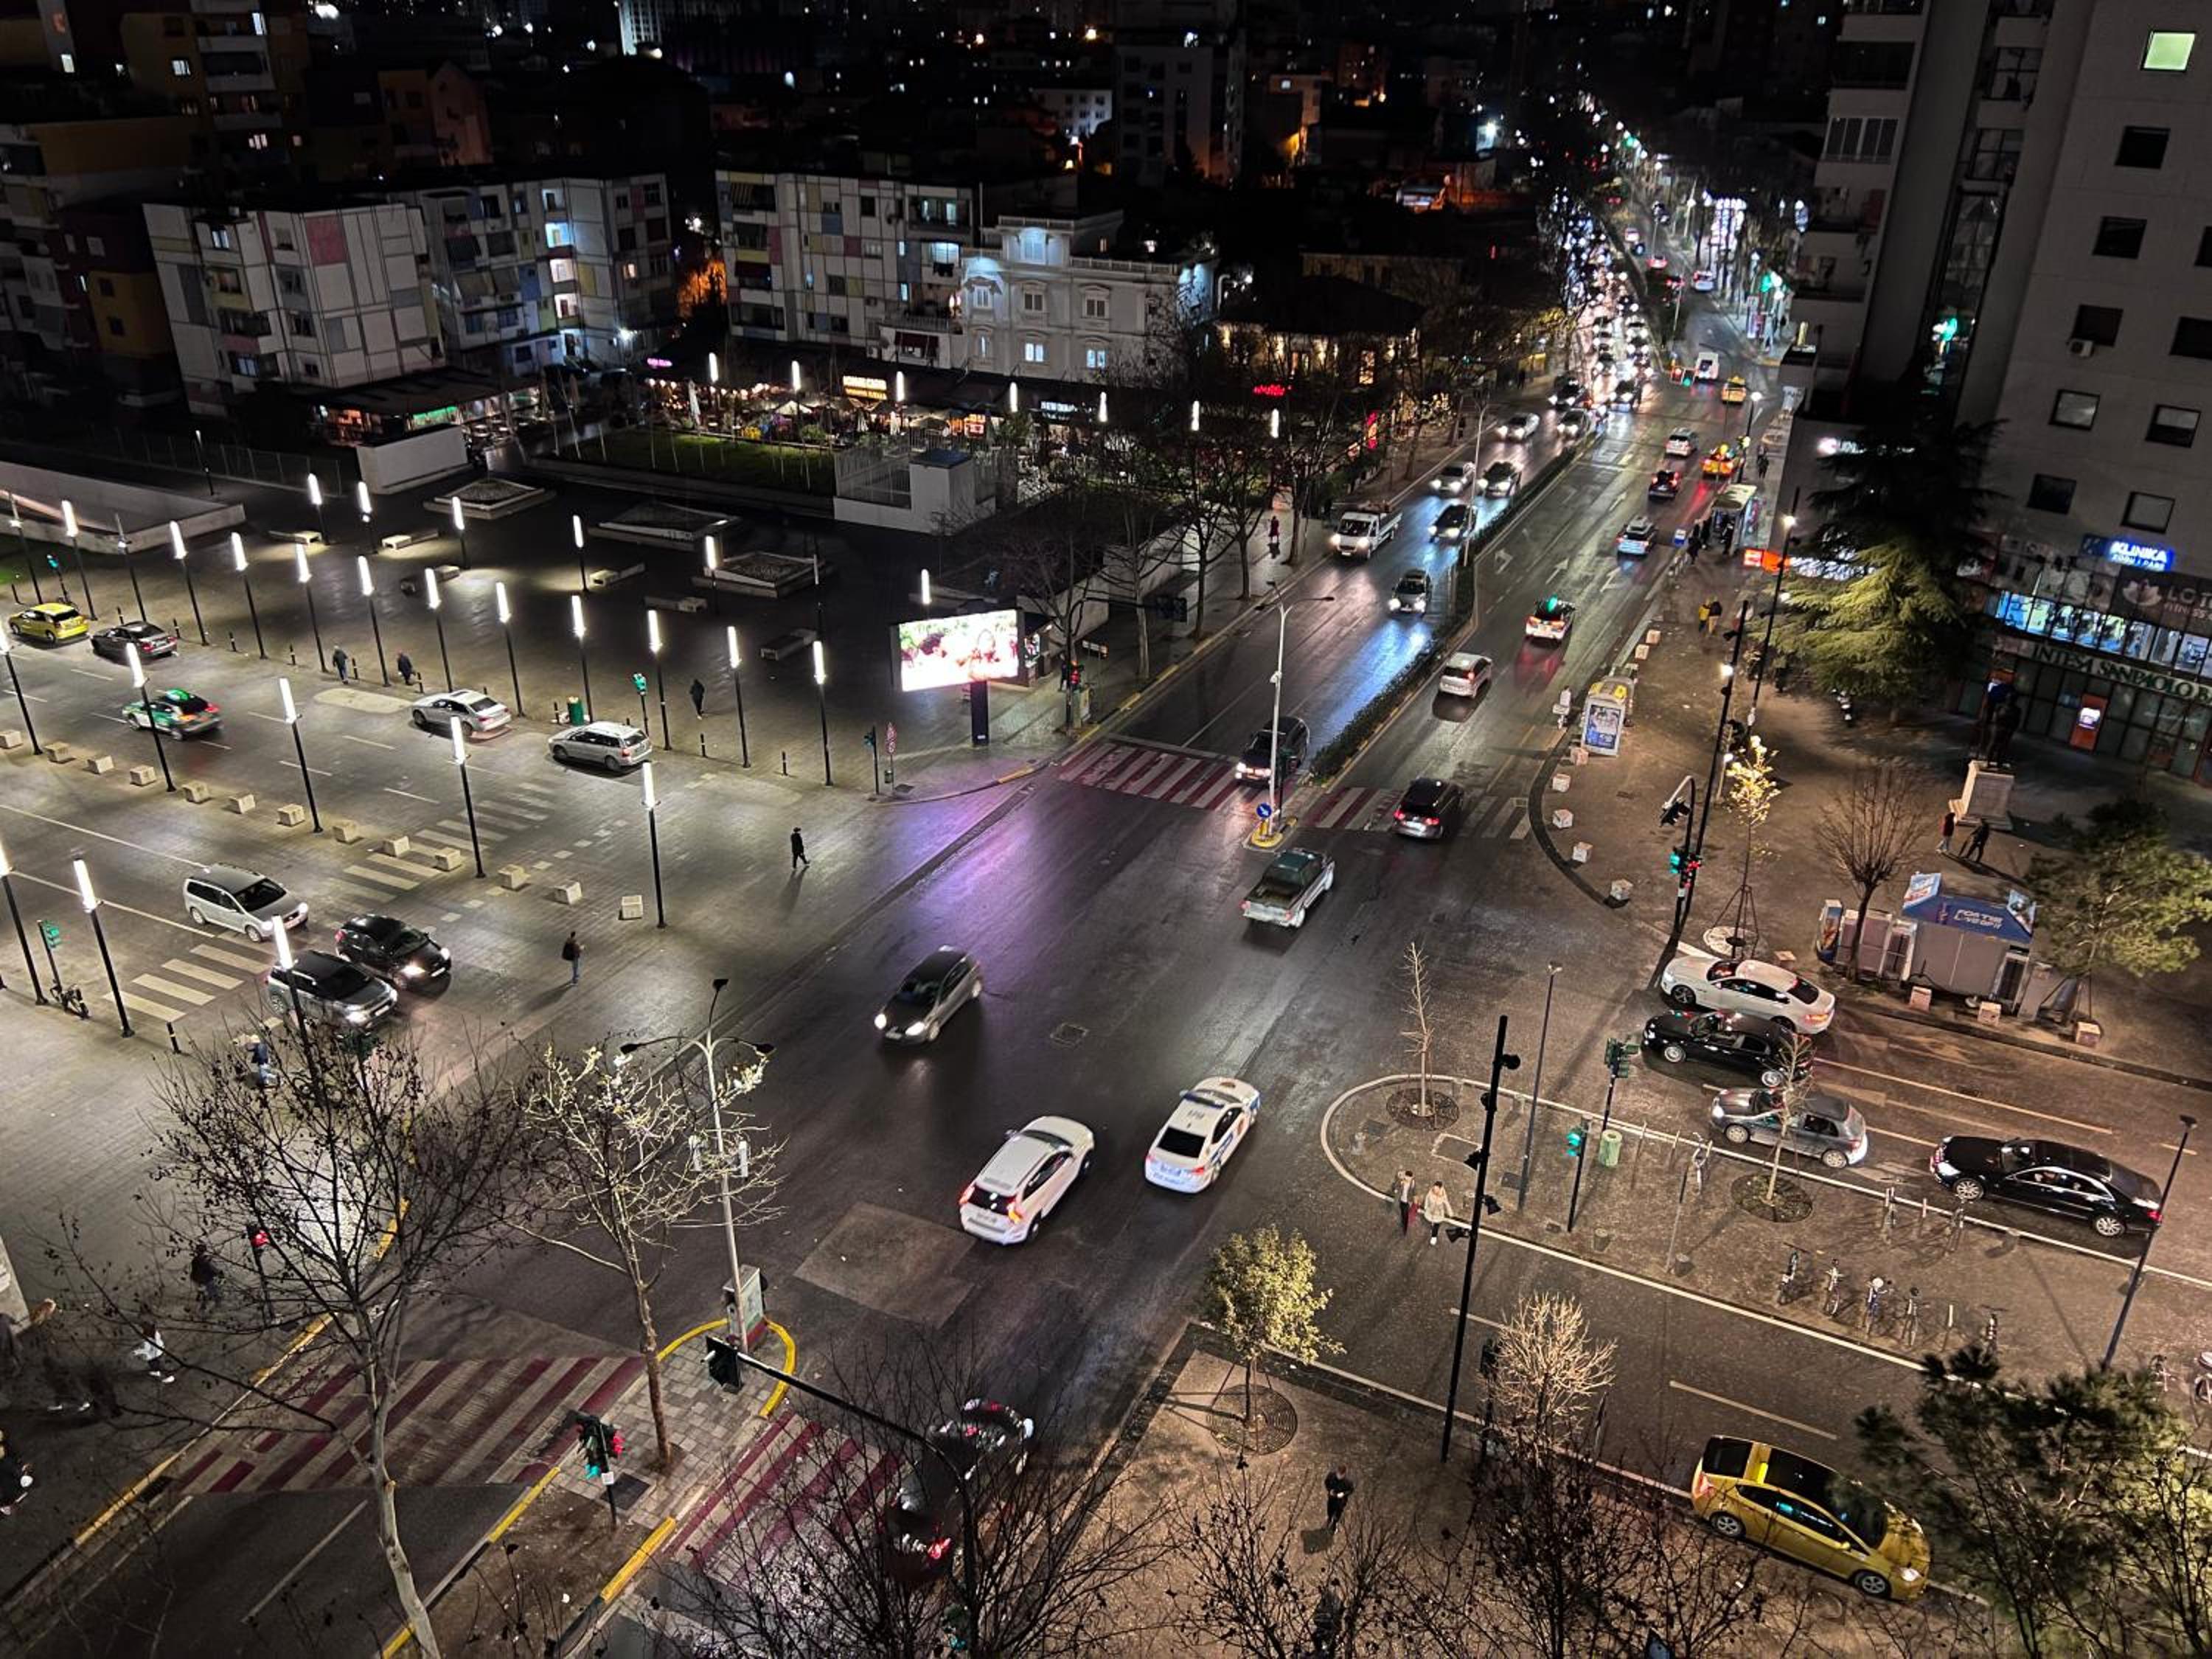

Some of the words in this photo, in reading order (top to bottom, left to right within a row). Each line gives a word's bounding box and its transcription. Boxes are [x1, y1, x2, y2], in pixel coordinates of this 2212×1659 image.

[2110, 541, 2167, 563] KLINIKA
[2033, 644, 2092, 674] INTESA
[2097, 661, 2194, 698] SANPAOLO
